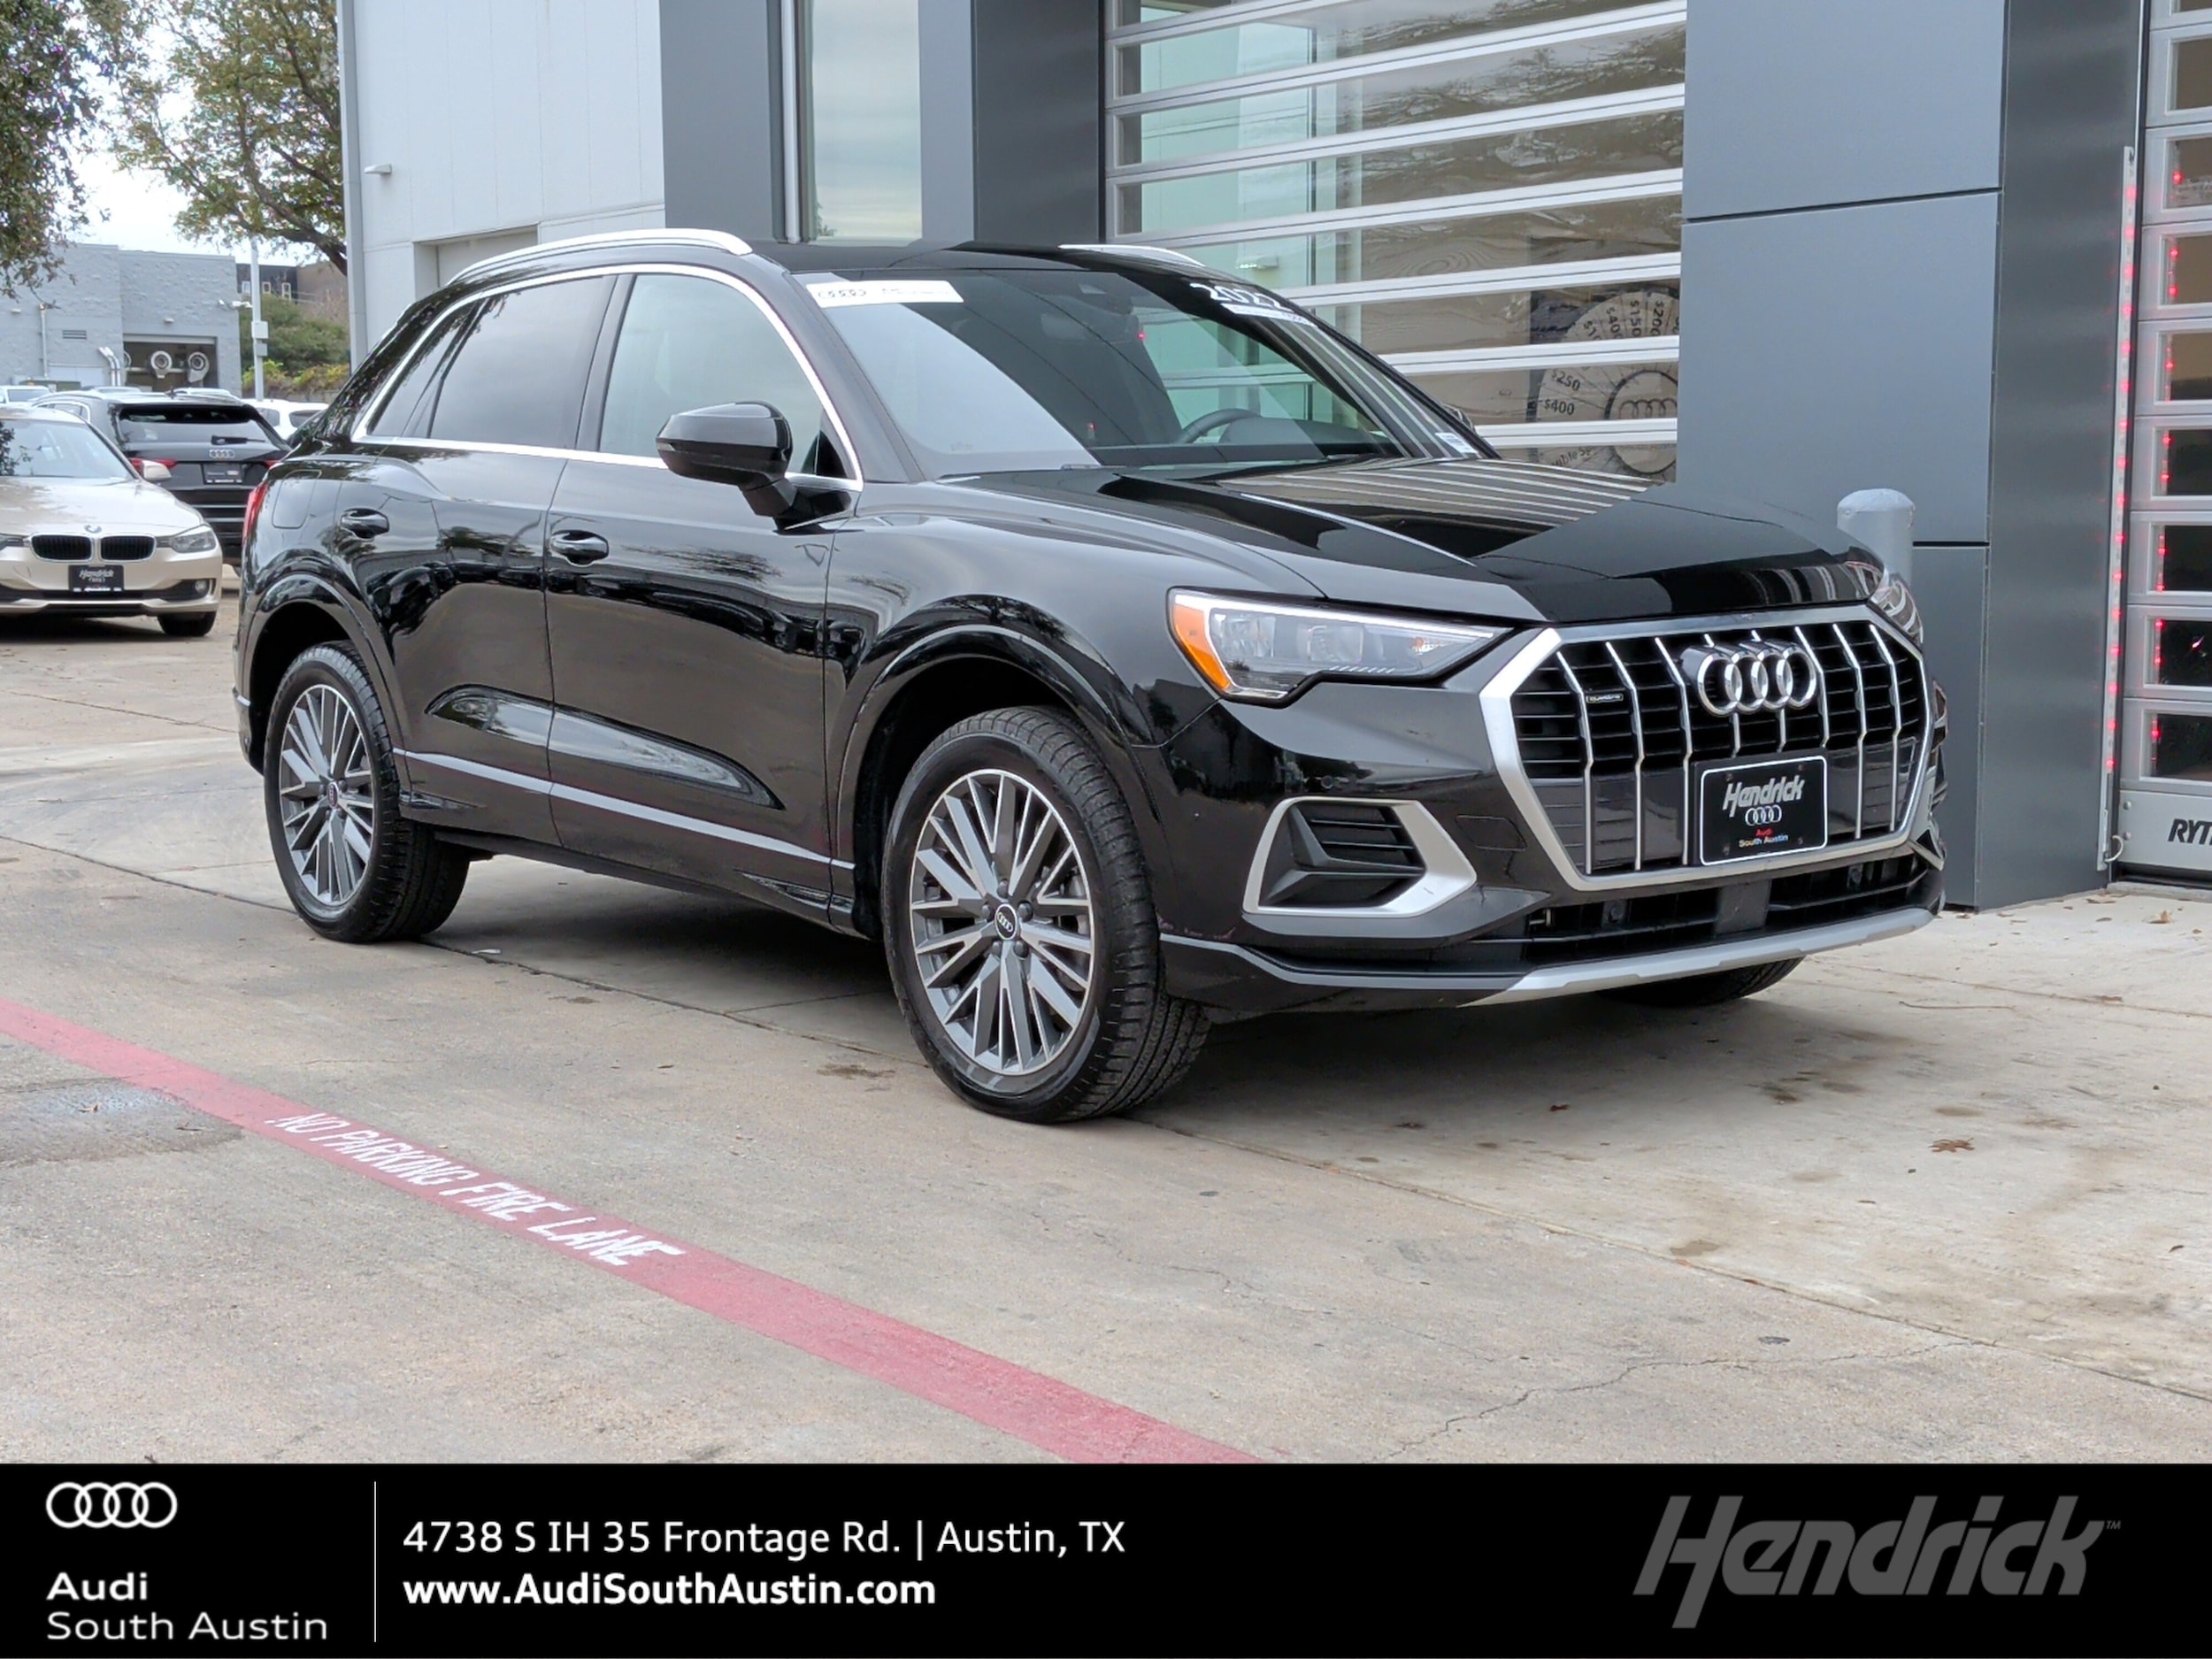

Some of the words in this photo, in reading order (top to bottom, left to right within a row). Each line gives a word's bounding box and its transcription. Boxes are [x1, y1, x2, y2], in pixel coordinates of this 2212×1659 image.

[1630, 300, 1642, 336] $150
[1550, 369, 1581, 391] $250
[1544, 399, 1575, 415] $400
[1722, 775, 1805, 818] Hendrick
[265, 1112, 351, 1134] NO
[309, 1129, 480, 1187] PARKING
[438, 1181, 574, 1222] FIRE
[526, 1217, 687, 1267] LANE
